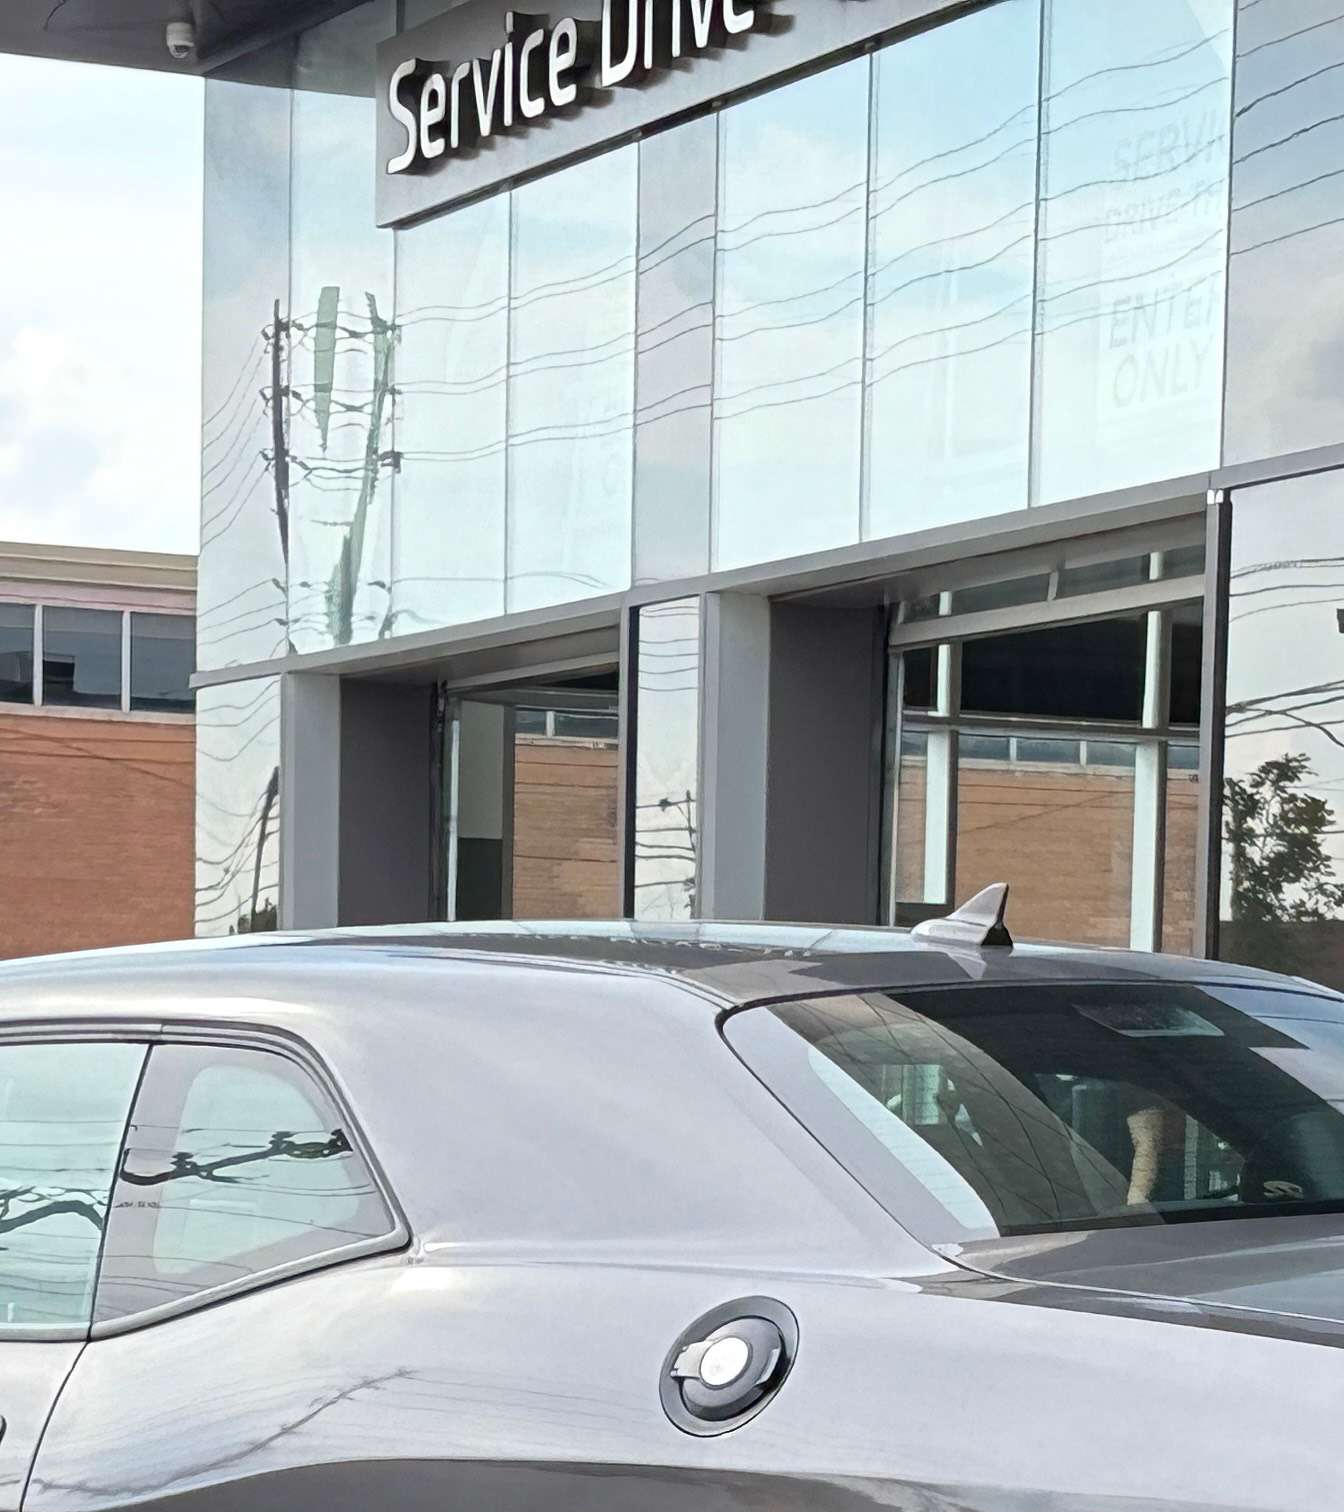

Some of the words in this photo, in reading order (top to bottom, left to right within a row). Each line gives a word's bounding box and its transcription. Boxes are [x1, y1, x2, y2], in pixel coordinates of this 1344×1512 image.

[387, 11, 577, 174] Service
[1114, 108, 1224, 178] SERVI
[1113, 333, 1214, 408] ONLY
